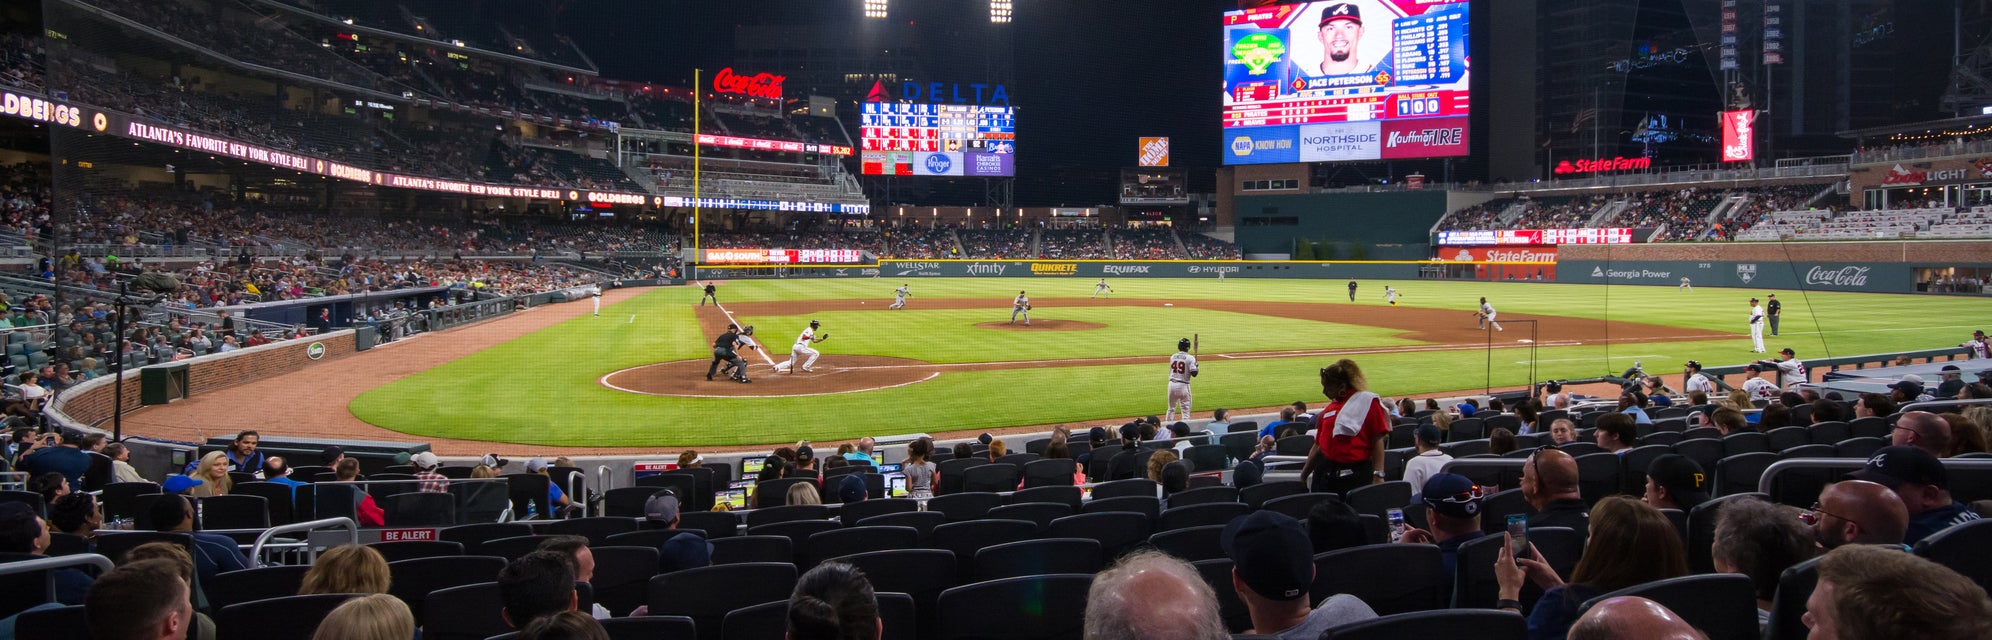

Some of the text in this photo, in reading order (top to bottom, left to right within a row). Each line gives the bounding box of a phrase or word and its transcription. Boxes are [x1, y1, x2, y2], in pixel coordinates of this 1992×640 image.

[1248, 12, 1273, 21] PIRATES
[1309, 78, 1328, 88] JACE
[1328, 74, 1373, 86] PETERSON
[903, 82, 1009, 103] DELTA
[865, 105, 877, 113] NL
[1401, 100, 1437, 113] 1 0 0
[866, 129, 877, 137] AL
[1304, 134, 1376, 144] NORTHSIDE
[129, 122, 307, 169] ATLANTA'S FAVORITE NEW YORK STYLE DELI
[1235, 140, 1292, 150] NAPA KNOW HOW
[928, 156, 950, 172] Kroger
[1882, 169, 1966, 185] Coors LIGHT
[393, 176, 560, 199] ATLANTA'S FAVORITE NEW YORK STYLE DELI
[588, 192, 645, 204] GOLDBERGS
[708, 252, 760, 260] GAS SOUTH
[966, 262, 1006, 276] xfinity
[1031, 263, 1077, 272] QUIKRETE
[1103, 265, 1150, 275] EQUIFAX
[1606, 269, 1670, 279] Georgia Power
[1806, 266, 1870, 286] Coca-Cola
[1171, 361, 1185, 374] 49
[1694, 473, 1704, 487] P
[386, 531, 431, 540] BE ALERT
